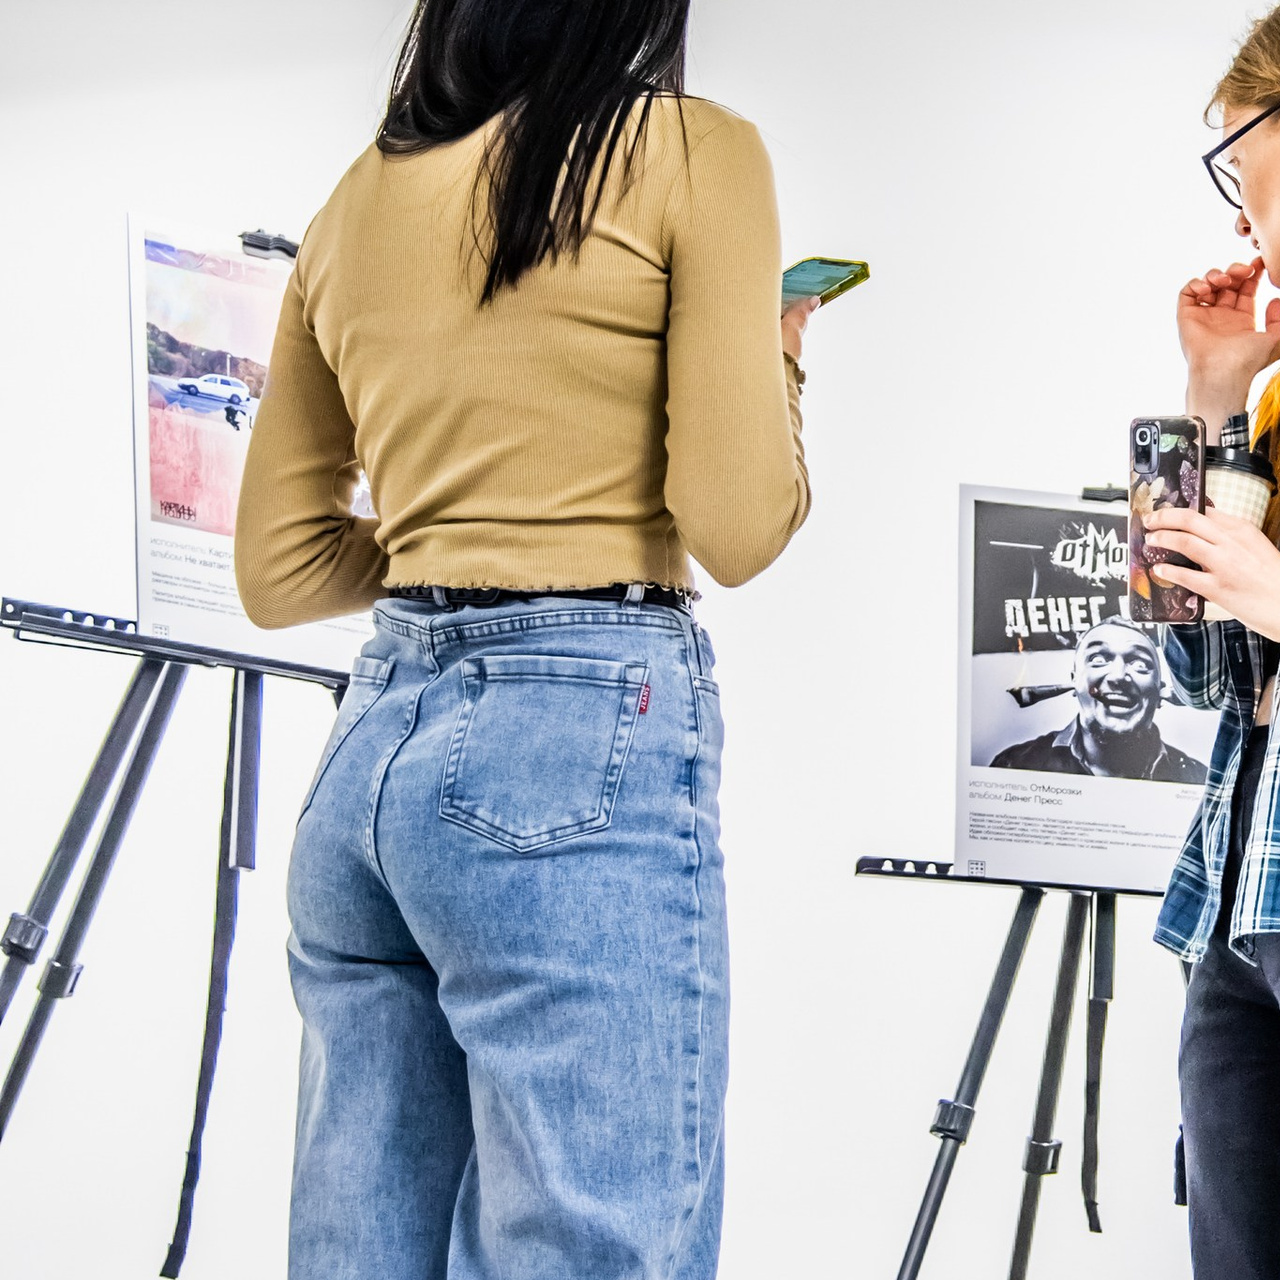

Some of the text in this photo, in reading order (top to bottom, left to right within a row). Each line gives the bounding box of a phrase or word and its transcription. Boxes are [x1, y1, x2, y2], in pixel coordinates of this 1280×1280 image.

[1005, 596, 1106, 637] ДЕНЕГ
[640, 686, 650, 710] JEANS
[1003, 792, 1032, 802] Денег
[1034, 794, 1062, 805] Пресс
[1030, 783, 1082, 796] ОтМорозки
